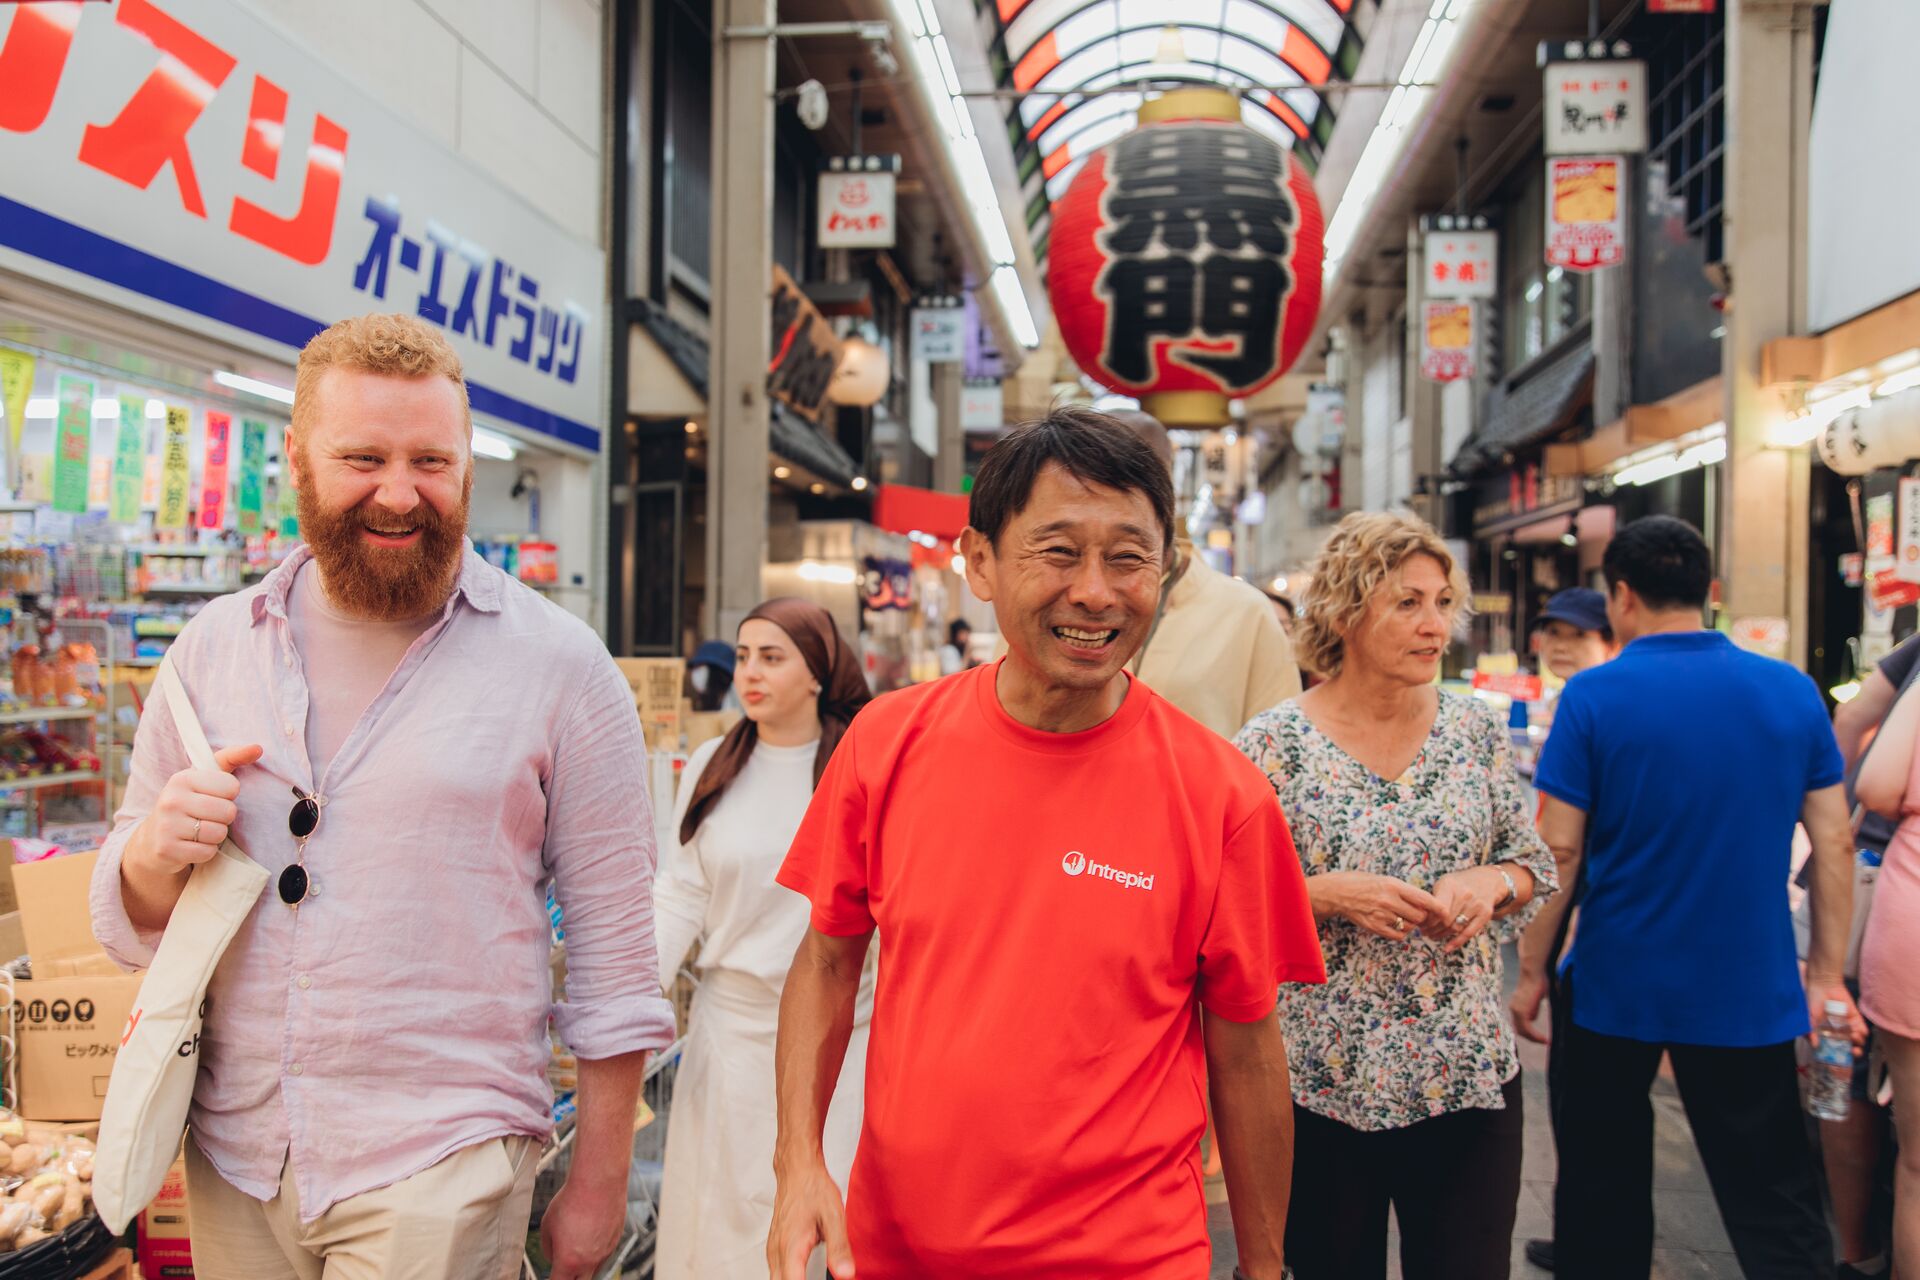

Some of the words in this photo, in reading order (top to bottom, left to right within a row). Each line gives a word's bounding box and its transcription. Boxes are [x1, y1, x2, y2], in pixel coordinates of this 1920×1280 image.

[353, 193, 591, 384] オーエスドラッグ
[1087, 859, 1155, 891] Intrepid
